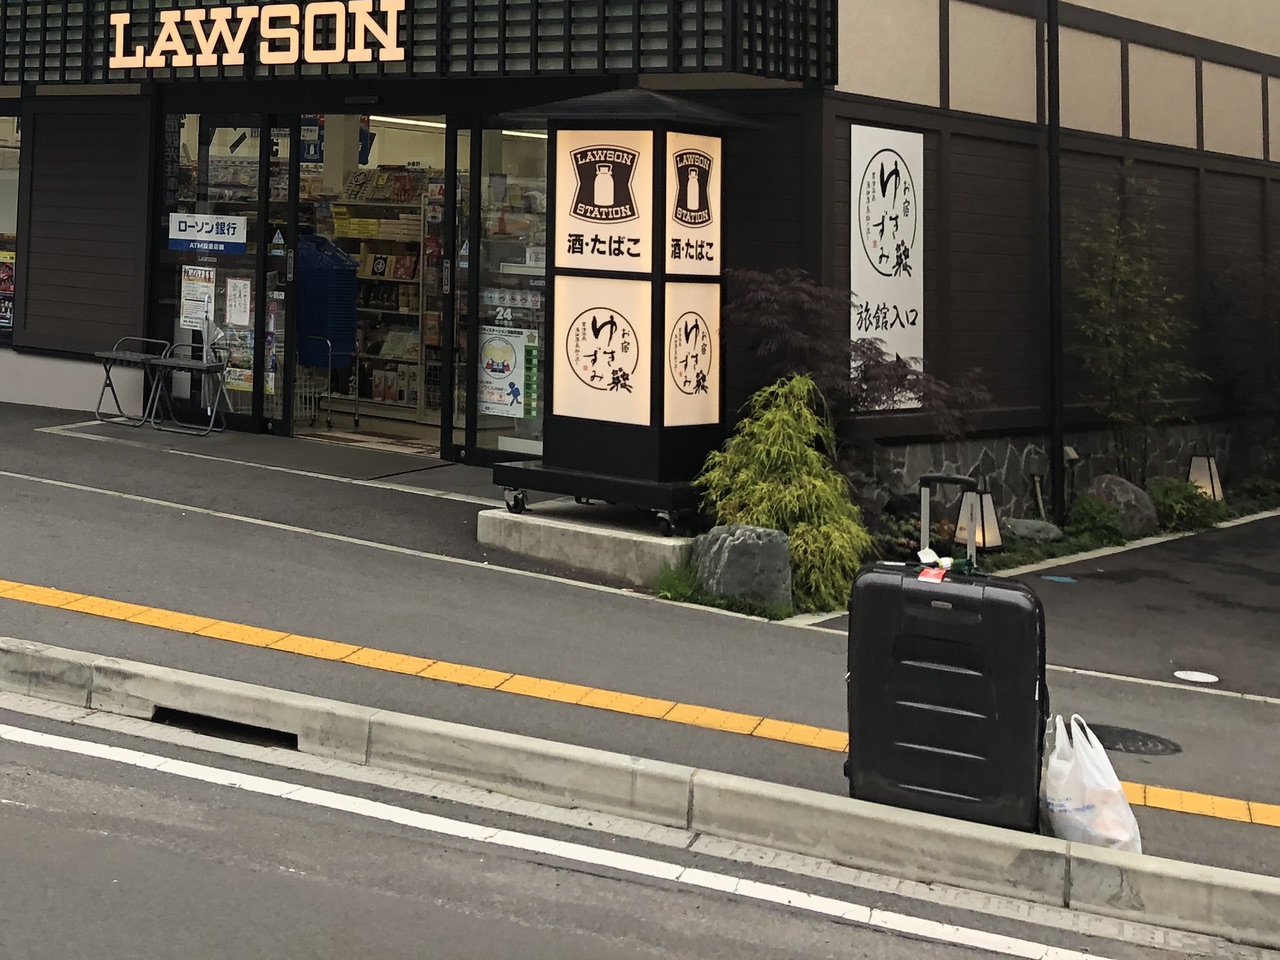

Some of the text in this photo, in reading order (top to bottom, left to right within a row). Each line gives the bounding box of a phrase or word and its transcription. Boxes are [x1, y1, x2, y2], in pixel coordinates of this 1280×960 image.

[576, 150, 633, 166] LAWSON
[676, 156, 710, 172] LAWSON
[576, 203, 632, 220] STATION
[676, 206, 709, 223] STATION
[178, 220, 237, 236] ローソン銀行
[567, 233, 641, 259] 酒・たばこ
[671, 238, 714, 262] 酒・たばこ
[495, 306, 512, 321] 24
[855, 300, 919, 333] 旅館入口
[621, 328, 630, 354] お宿
